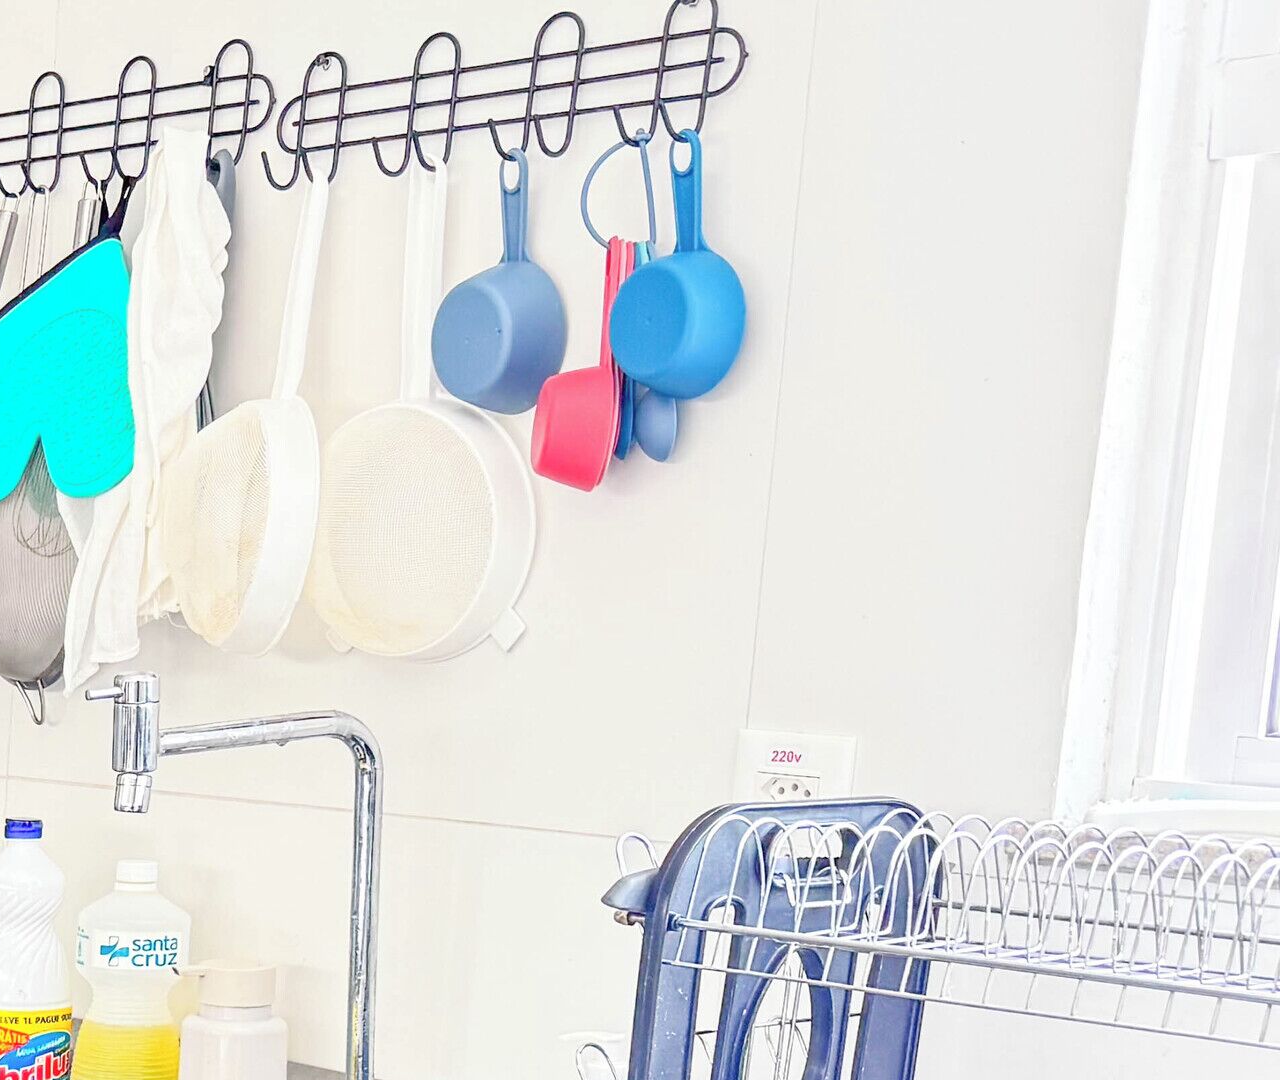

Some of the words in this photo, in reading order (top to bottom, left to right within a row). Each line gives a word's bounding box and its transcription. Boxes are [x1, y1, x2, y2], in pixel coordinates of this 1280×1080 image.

[771, 750, 802, 763] 220v
[131, 936, 178, 952] santa
[131, 952, 178, 967] cruz
